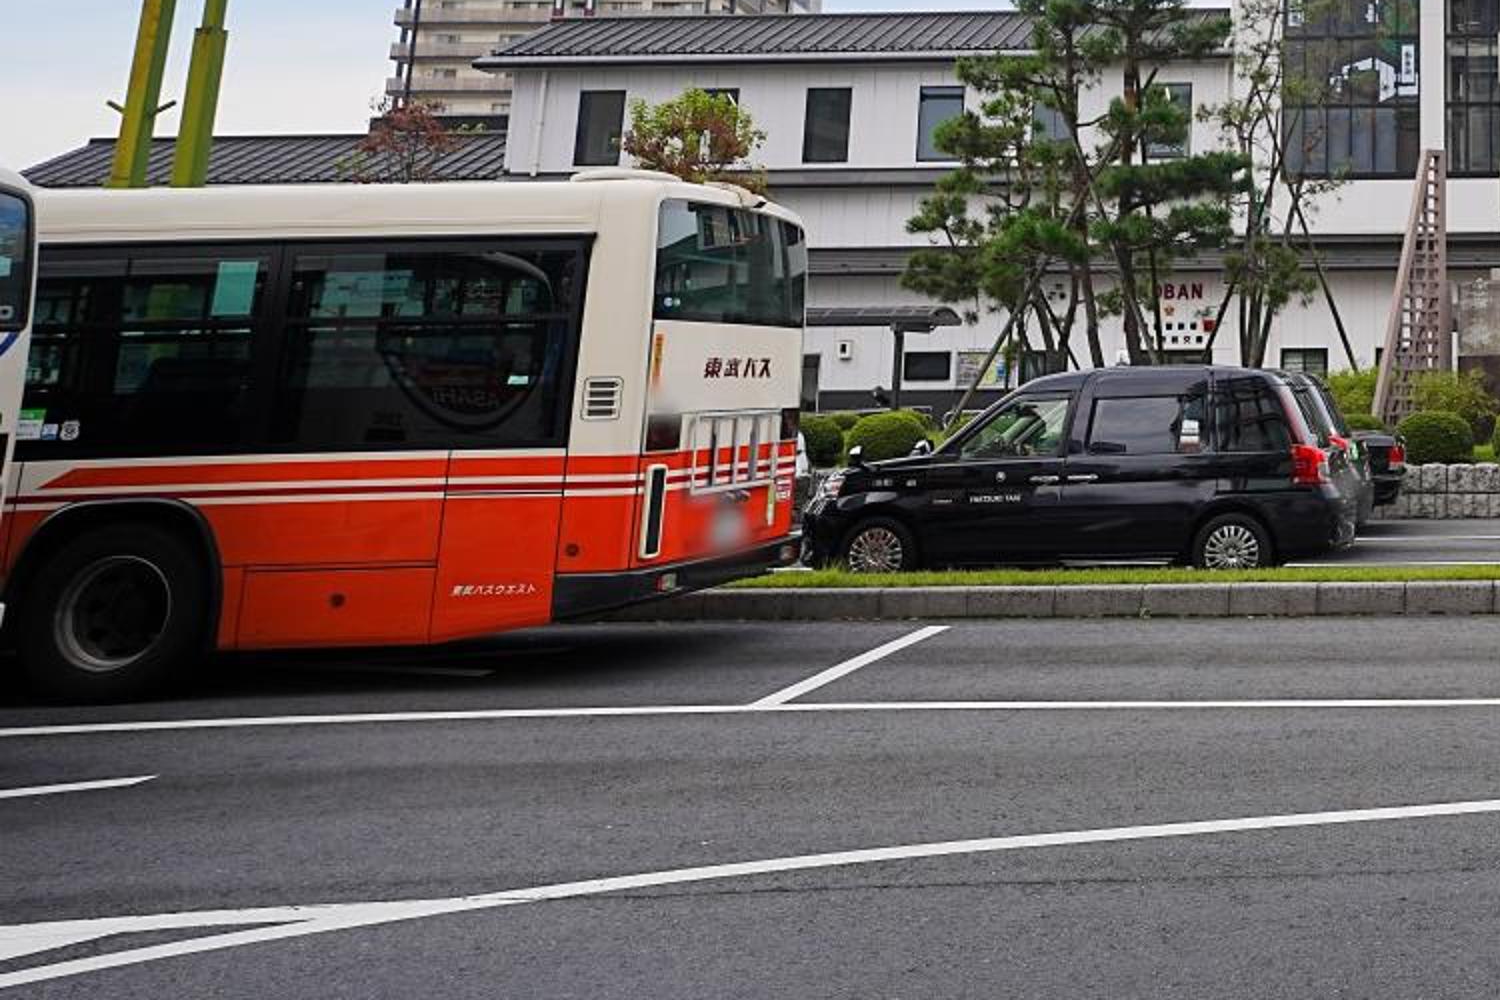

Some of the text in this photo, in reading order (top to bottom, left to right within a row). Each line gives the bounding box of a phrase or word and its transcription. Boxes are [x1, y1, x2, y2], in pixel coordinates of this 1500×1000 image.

[704, 357, 771, 378] 東武バス
[452, 583, 536, 597] 東武バスウエスト
